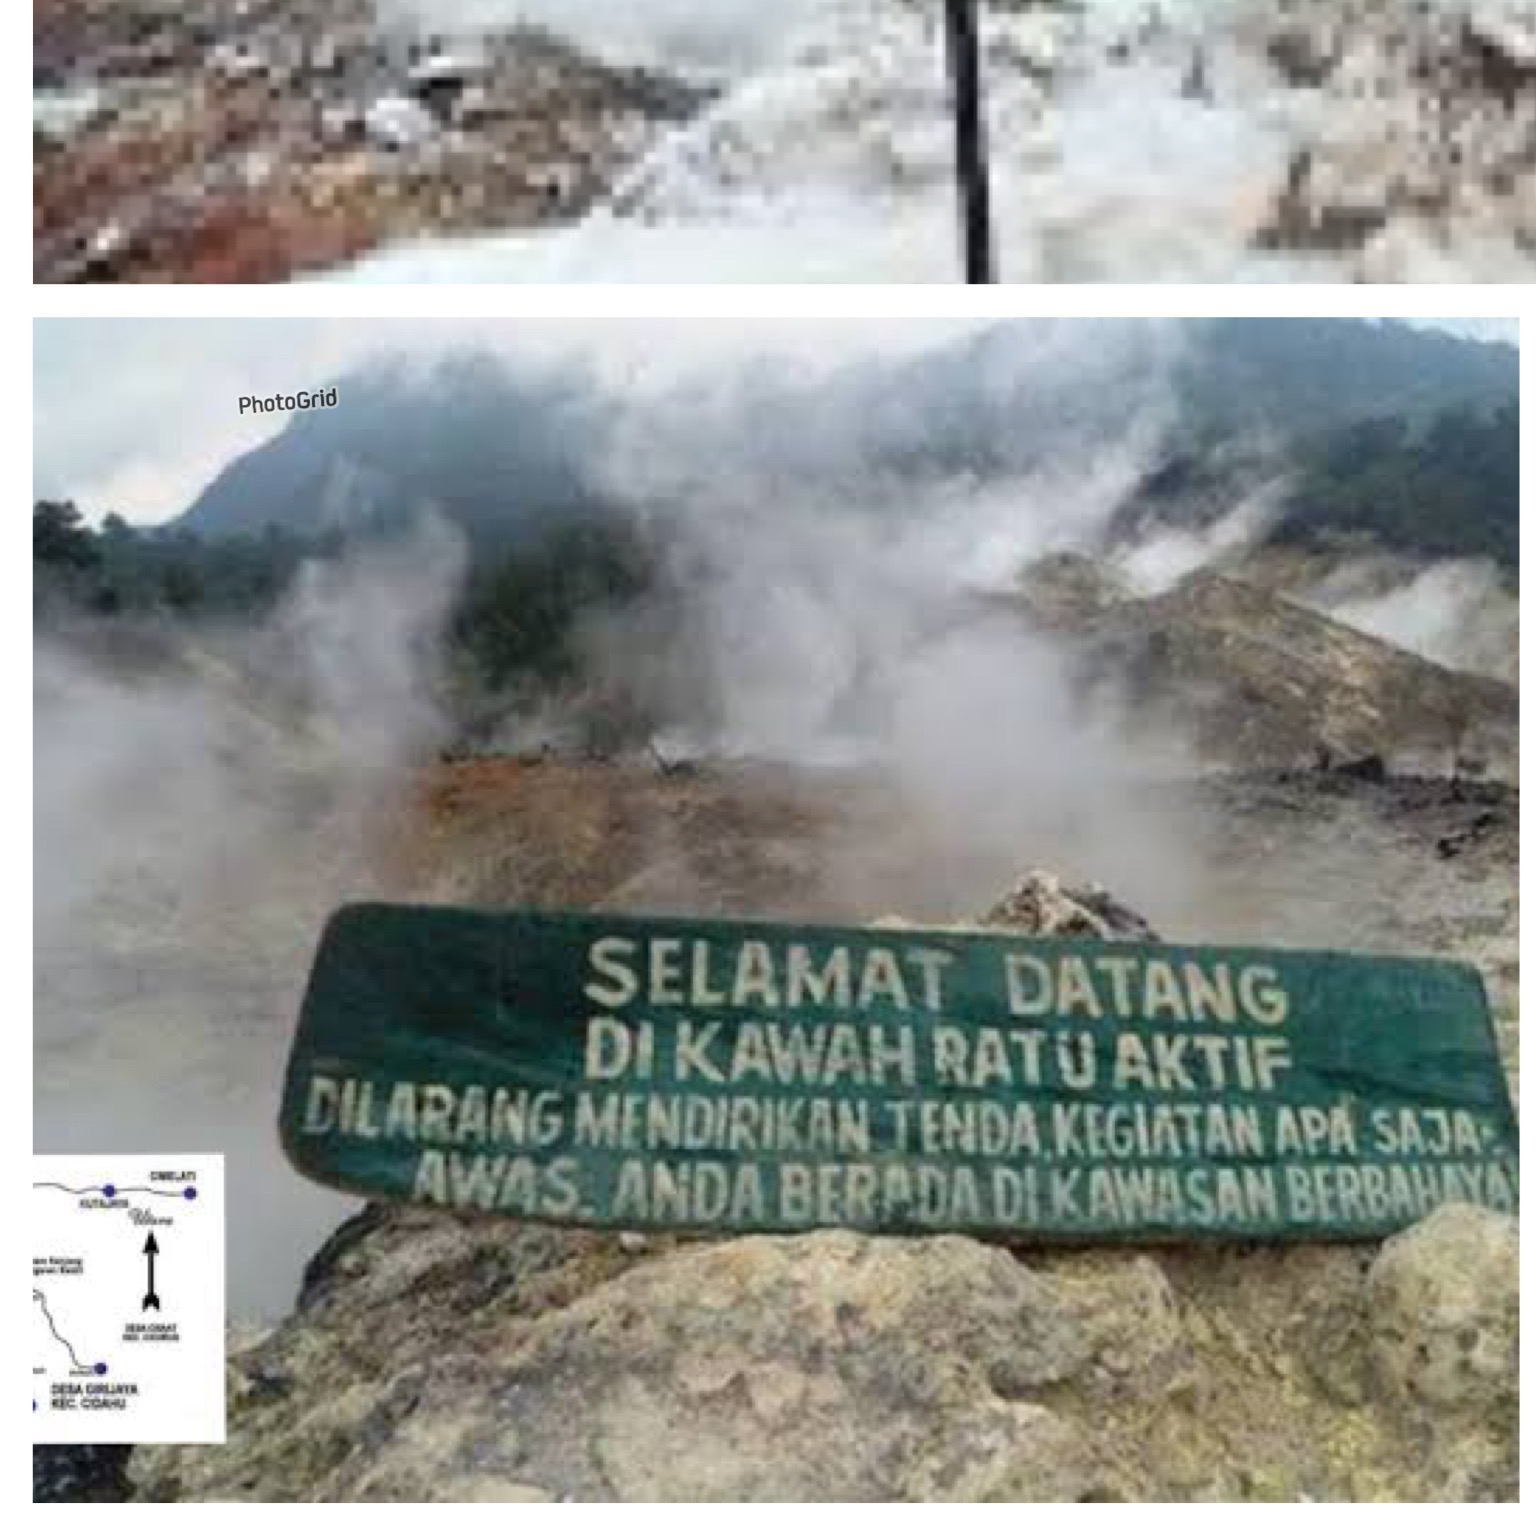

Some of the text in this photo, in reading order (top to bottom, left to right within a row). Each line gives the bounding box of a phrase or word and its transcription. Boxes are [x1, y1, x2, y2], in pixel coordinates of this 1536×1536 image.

[583, 936, 1289, 1026] SELAMAT DATANG
[585, 1016, 1293, 1092] DI KAWAH RATU AKTIF
[302, 1076, 563, 1147] DILARANG
[573, 1090, 871, 1154] MENDIRIKAN
[1276, 1102, 1358, 1156] APA
[613, 1158, 763, 1223] ANDA
[779, 1162, 981, 1225] BERADA
[993, 1166, 1039, 1224] DI
[1050, 1165, 1278, 1225] KAWASAN
